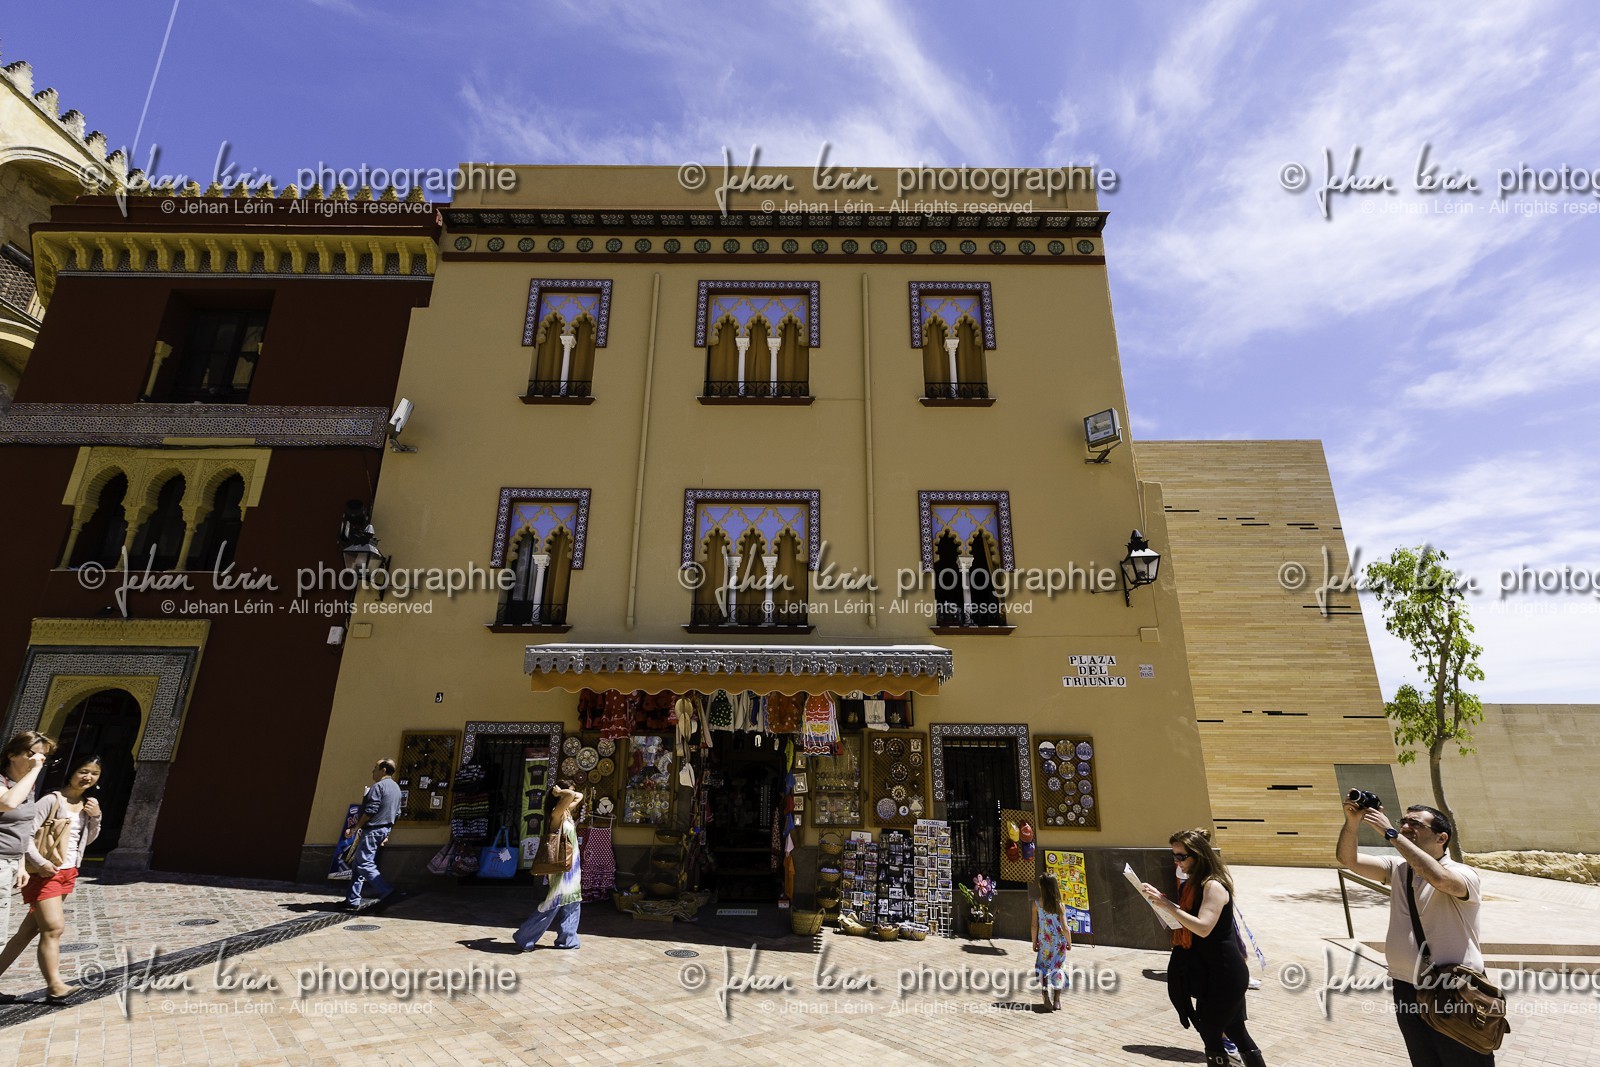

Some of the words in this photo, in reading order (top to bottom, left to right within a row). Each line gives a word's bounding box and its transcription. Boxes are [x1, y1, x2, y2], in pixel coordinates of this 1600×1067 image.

[1069, 656, 1115, 665] PLAZA
[1079, 666, 1107, 675] DEL
[1063, 677, 1125, 686] TRIUNFO
